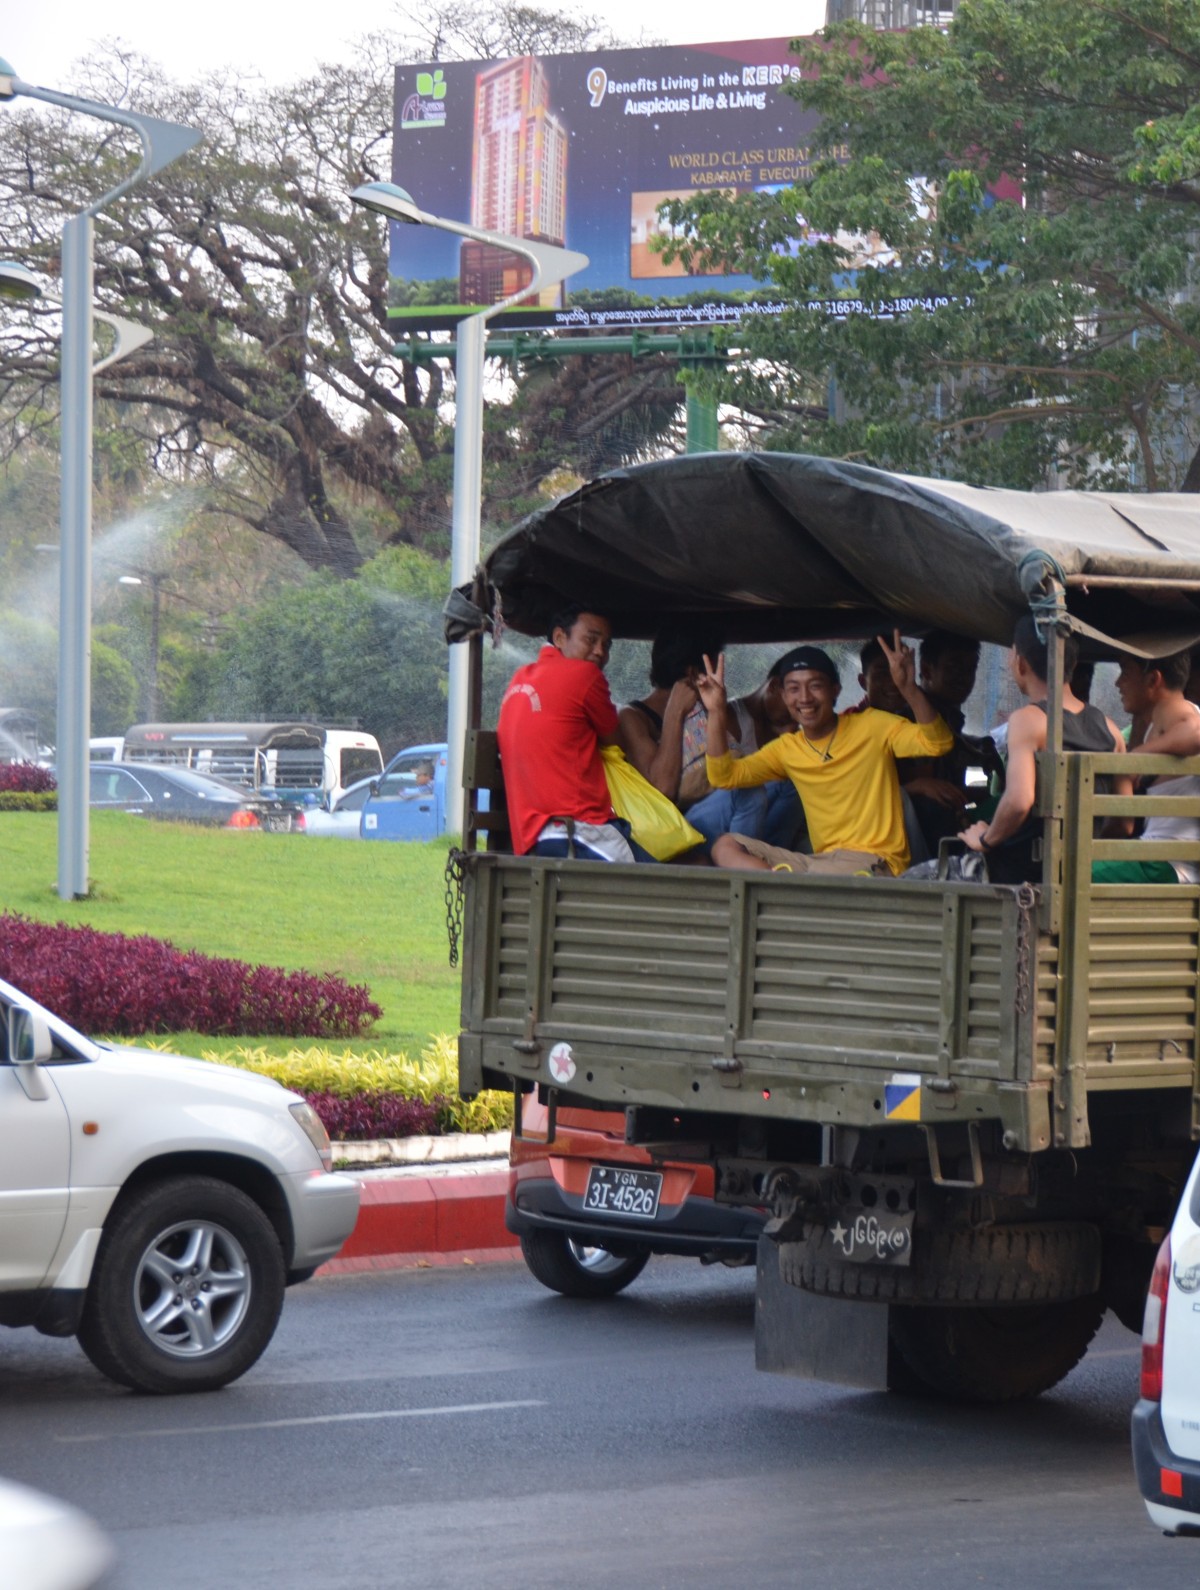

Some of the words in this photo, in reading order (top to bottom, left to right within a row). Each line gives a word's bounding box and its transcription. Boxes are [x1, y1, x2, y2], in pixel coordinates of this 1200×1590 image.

[587, 67, 607, 107] 9
[608, 79, 658, 94] Benefits
[661, 75, 699, 92] Living
[702, 72, 715, 87] in
[719, 70, 740, 86] the
[624, 97, 690, 117] Auspicious
[691, 94, 714, 111] Life
[716, 92, 728, 109] &
[729, 91, 766, 110] Living
[669, 152, 719, 169] WORLD
[721, 149, 765, 166] CLASS
[690, 170, 752, 185] KABARAYE
[614, 1171, 637, 1185] YGN
[589, 1182, 654, 1213] 3I-4526
